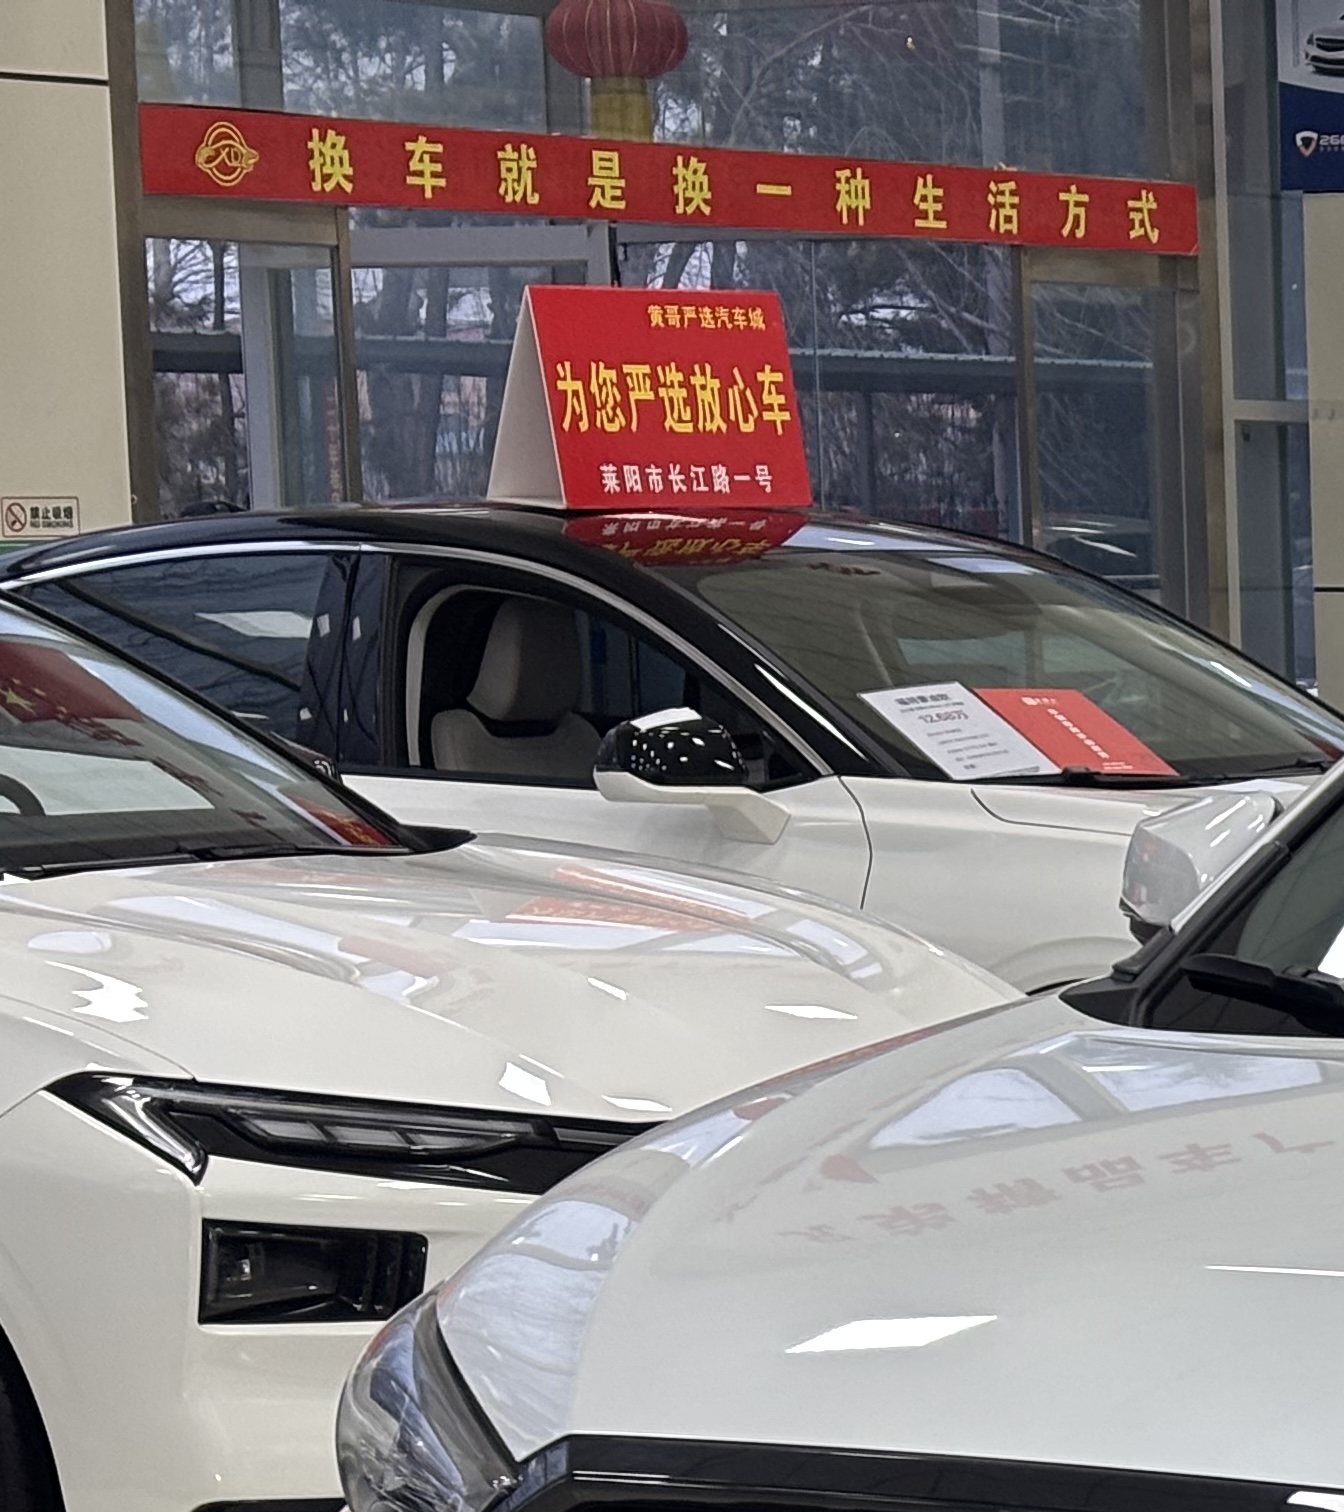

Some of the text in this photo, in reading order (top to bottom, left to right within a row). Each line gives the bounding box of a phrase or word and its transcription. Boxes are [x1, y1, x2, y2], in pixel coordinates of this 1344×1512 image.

[308, 128, 1160, 243] 换车就是换一种生活方式
[647, 305, 766, 331] 黄哥严选汽车城
[556, 361, 792, 436] 为您严选放心车
[599, 463, 773, 494] 莱阳市长江路一号
